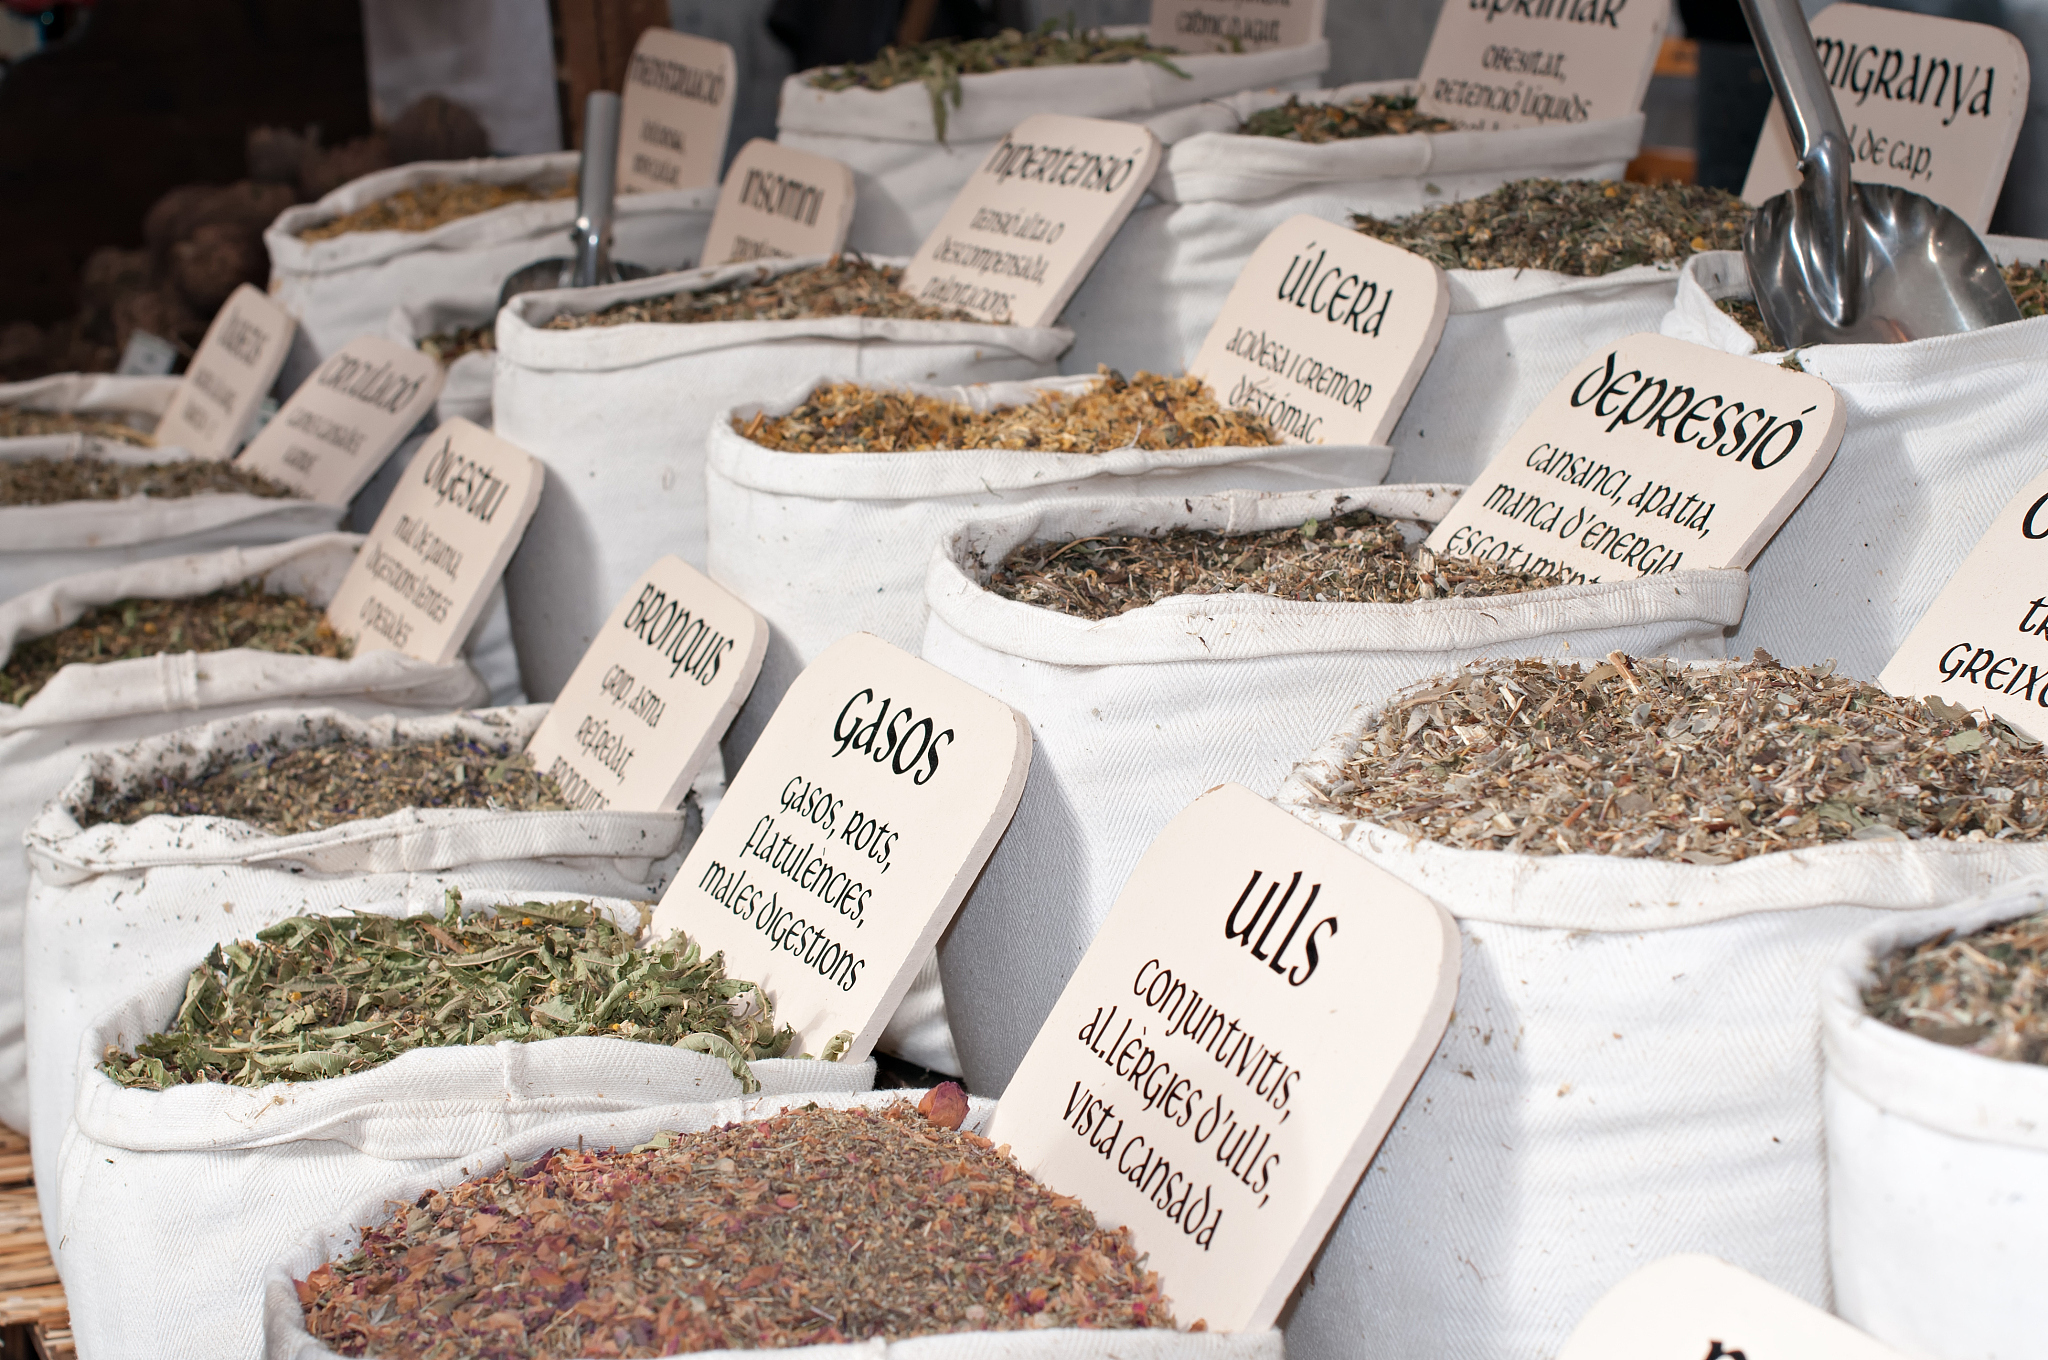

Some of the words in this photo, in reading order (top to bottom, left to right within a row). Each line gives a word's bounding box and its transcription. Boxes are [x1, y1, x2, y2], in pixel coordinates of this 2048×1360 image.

[1816, 36, 1994, 127] migranya
[1858, 127, 1889, 165] de
[1889, 140, 1932, 182] cap,
[1277, 241, 1393, 338] úlcera
[1226, 327, 1290, 374] acidesa
[1296, 357, 1372, 413] cremor
[1570, 351, 1818, 470] depressió
[424, 436, 510, 525] digestiu
[1483, 483, 1565, 537] manca
[1526, 443, 1632, 507] cansanci,
[1628, 481, 1716, 540] apatia,
[629, 685, 666, 729] asma
[739, 815, 872, 928] flatulències,
[780, 776, 844, 840] gasos,
[840, 810, 899, 873] rots,
[698, 860, 764, 921] males
[756, 892, 866, 992] digestions
[1224, 870, 1339, 986] ulls
[1133, 958, 1301, 1125] conjuntivitis,
[1063, 1081, 1124, 1160] vista
[1118, 1136, 1223, 1252] cansada
[1193, 1094, 1280, 1210] d'ulls,
